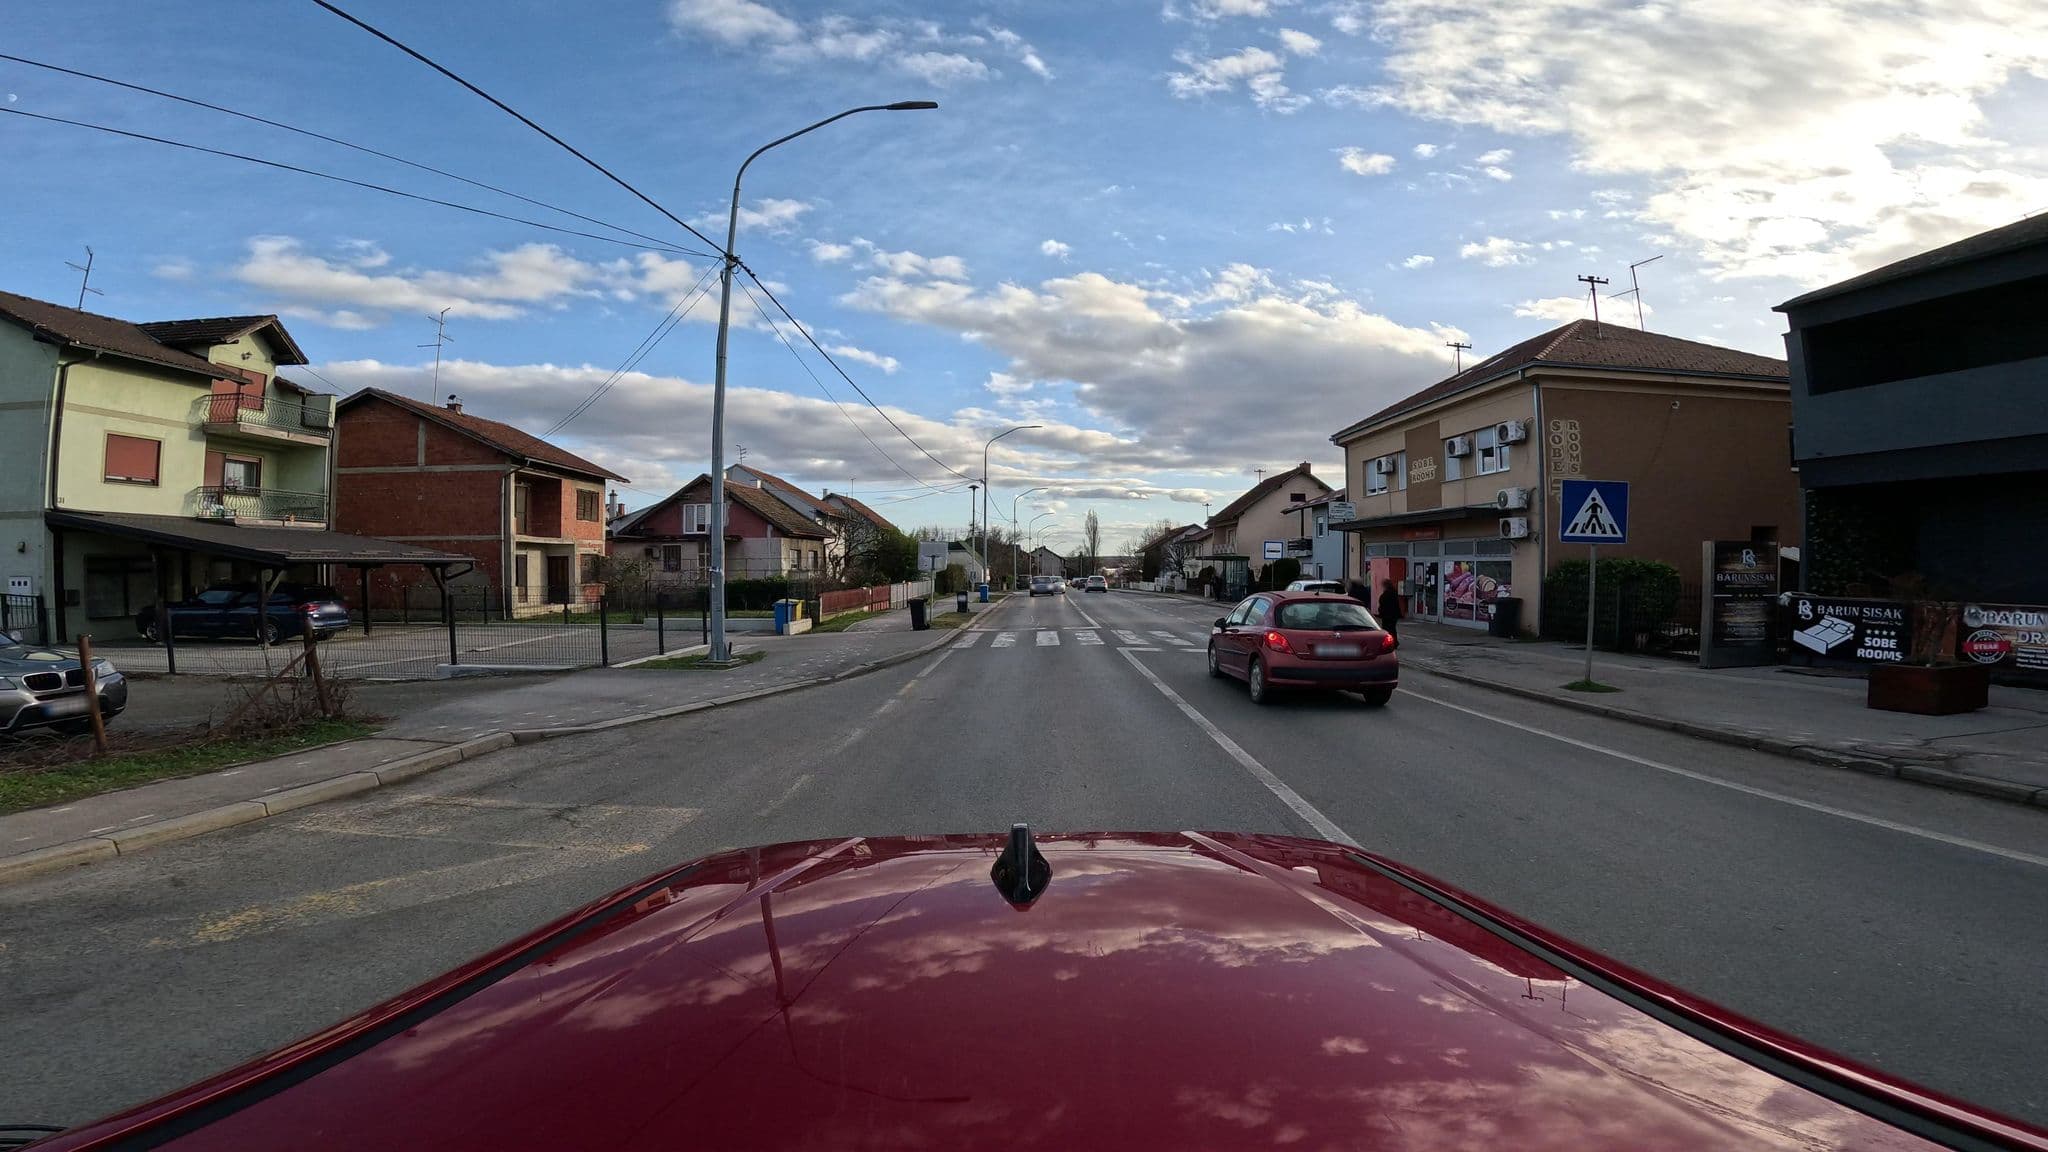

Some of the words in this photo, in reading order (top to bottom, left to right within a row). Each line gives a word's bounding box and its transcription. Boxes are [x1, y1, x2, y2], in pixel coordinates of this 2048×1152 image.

[1550, 420, 1564, 473] SOBE
[1568, 420, 1580, 473] ROOMS
[1412, 457, 1434, 469] SOBE
[1716, 573, 1750, 583] BARUN
[1751, 573, 1776, 583] SISAK
[1817, 605, 1860, 616] BARUN
[1862, 607, 1903, 619] SISAK
[1864, 637, 1898, 648] SOBE
[1856, 648, 1904, 661] ROOMS
